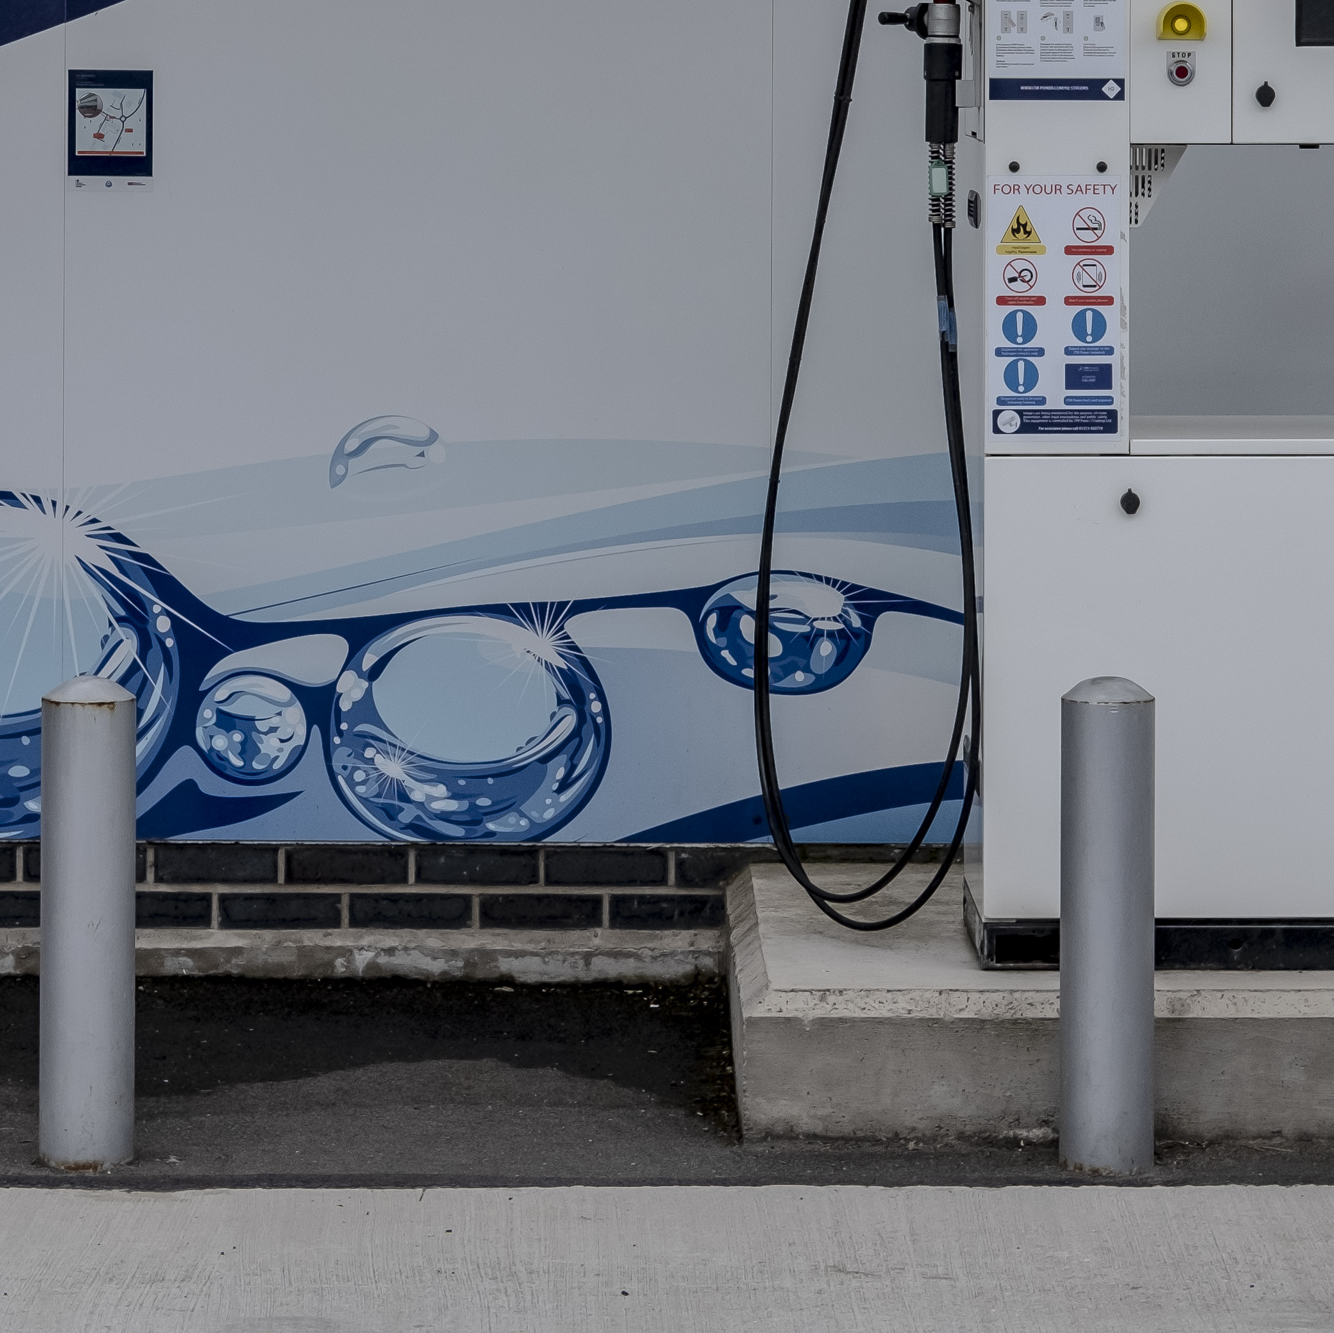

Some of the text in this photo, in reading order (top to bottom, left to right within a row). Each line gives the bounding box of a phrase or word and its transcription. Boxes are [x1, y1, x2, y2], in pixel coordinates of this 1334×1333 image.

[993, 183, 1118, 195] FOR YOUR SAFETY
